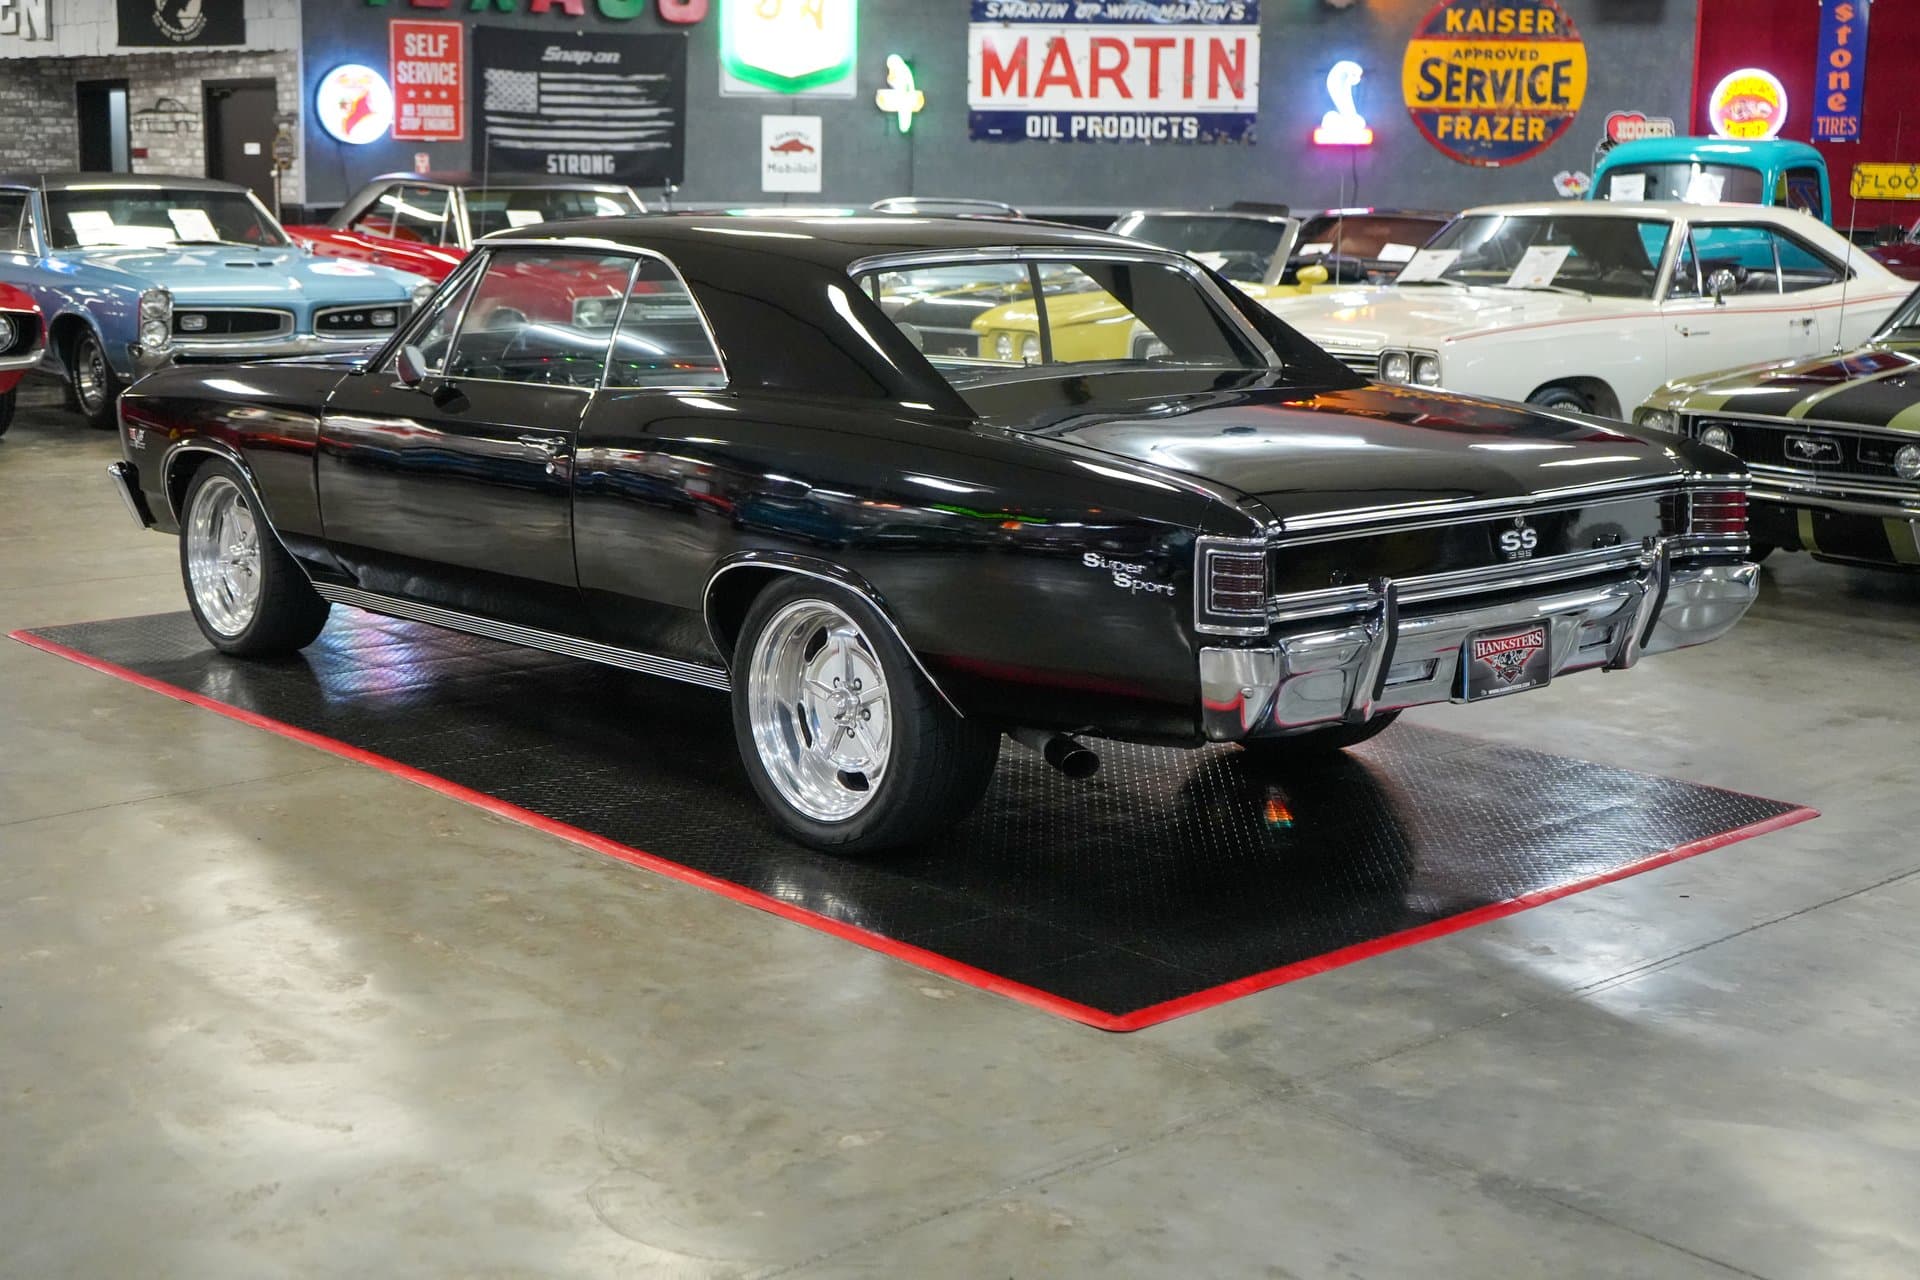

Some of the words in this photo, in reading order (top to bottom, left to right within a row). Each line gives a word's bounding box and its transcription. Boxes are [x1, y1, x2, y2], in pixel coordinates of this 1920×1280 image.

[1446, 8, 1556, 33] KAISER
[404, 32, 448, 58] SELF
[541, 45, 621, 65] Snap-on
[1453, 48, 1540, 61] APPROVED
[397, 61, 457, 85] SERVICE
[981, 37, 1246, 99] MARTIN
[1416, 57, 1573, 104] SERVICE
[1026, 116, 1063, 138] OIL
[1071, 117, 1199, 139] PRODUCTS
[1437, 115, 1547, 142] FRAZER
[1817, 116, 1857, 135] TIRES
[547, 154, 616, 174] STRONG
[329, 315, 363, 323] GTO
[1501, 528, 1537, 551] SS
[1082, 552, 1146, 575] Super
[1113, 572, 1176, 596] Sport
[1476, 631, 1542, 658] HANKSTERS
